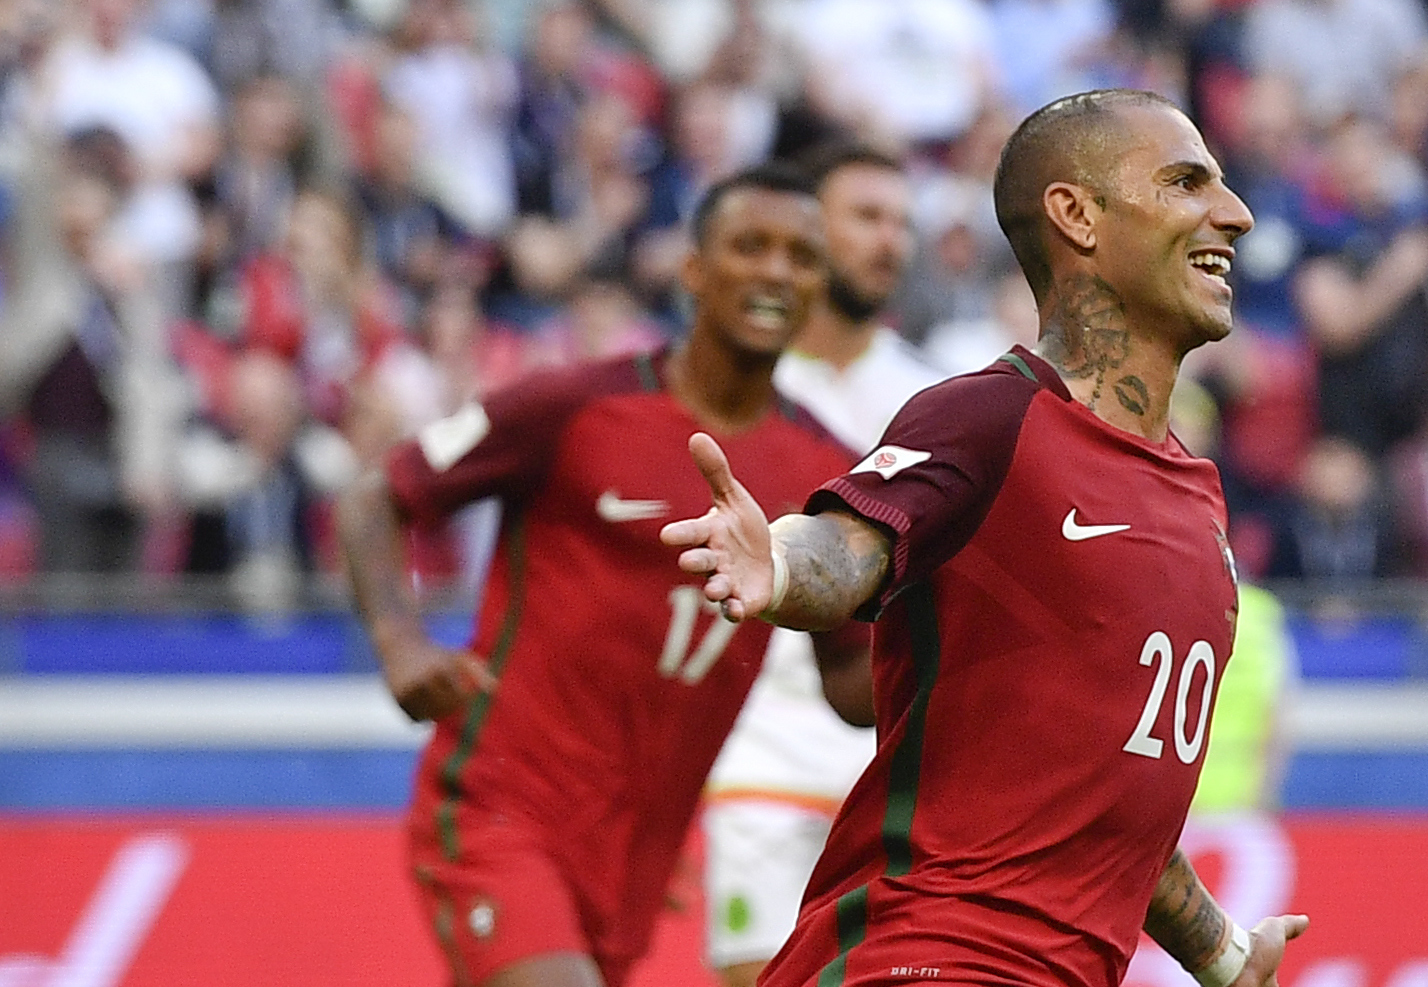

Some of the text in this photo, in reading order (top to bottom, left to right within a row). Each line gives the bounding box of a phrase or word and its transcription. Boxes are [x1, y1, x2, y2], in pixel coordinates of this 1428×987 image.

[658, 585, 741, 684] 17
[1122, 630, 1215, 765] 20
[890, 966, 941, 978] DRI-FIT
